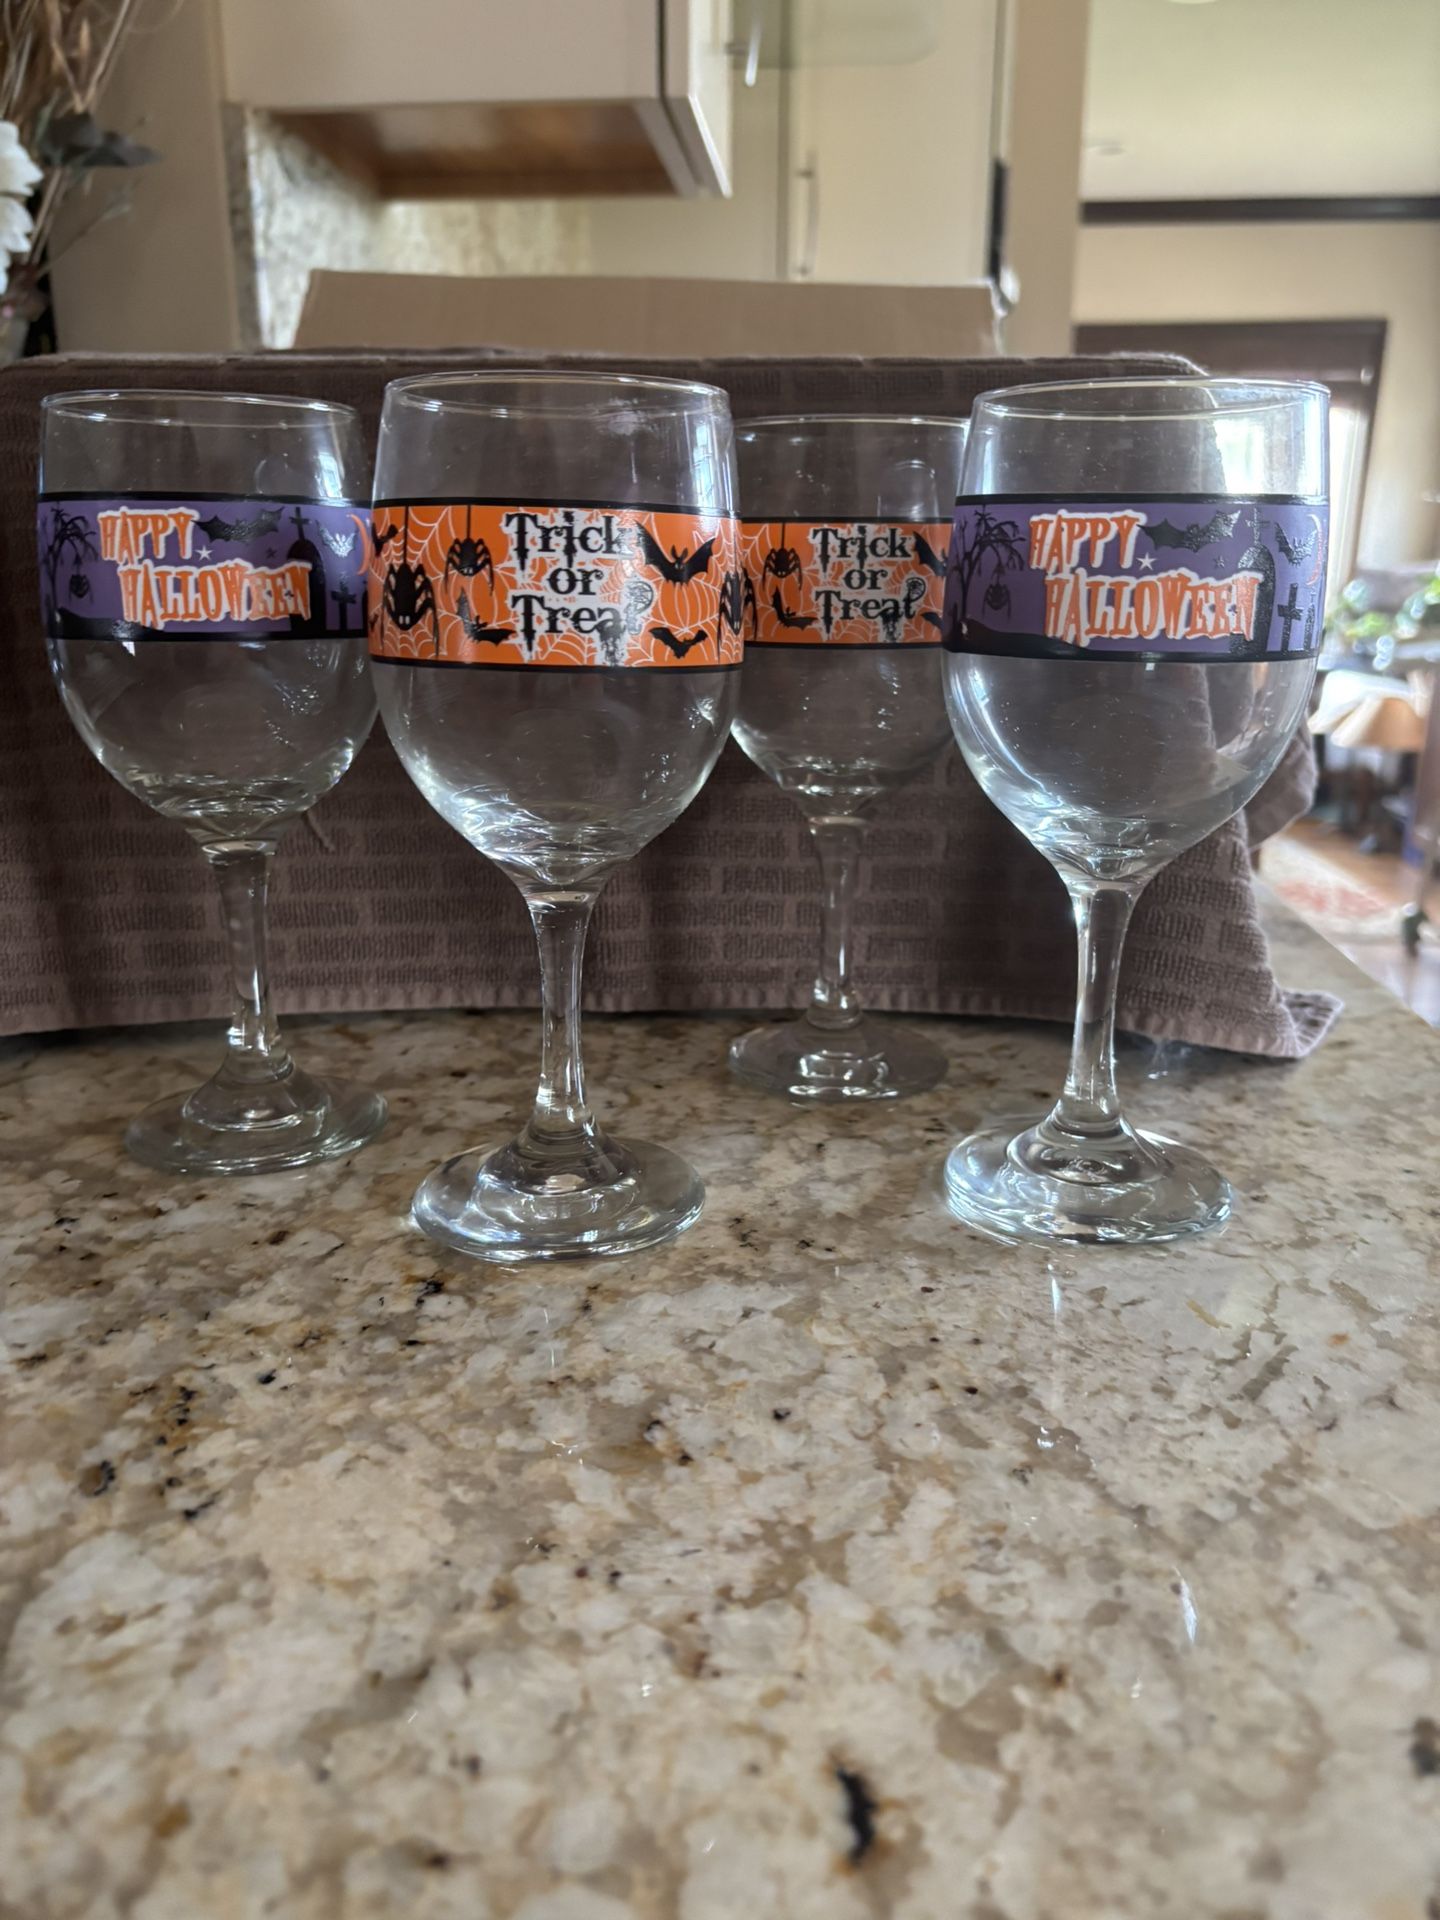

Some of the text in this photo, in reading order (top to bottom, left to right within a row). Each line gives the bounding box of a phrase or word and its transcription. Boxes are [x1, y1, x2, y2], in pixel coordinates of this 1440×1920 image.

[98, 507, 199, 564] HAPPY
[504, 511, 634, 572] Trick
[812, 525, 912, 574] Trick
[1029, 510, 1147, 573] HAPPY
[117, 559, 312, 630] HALLOWEEN
[547, 567, 605, 596] or
[815, 577, 927, 640] Treat
[843, 568, 889, 591] or
[1043, 568, 1263, 647] HALLOWEEN
